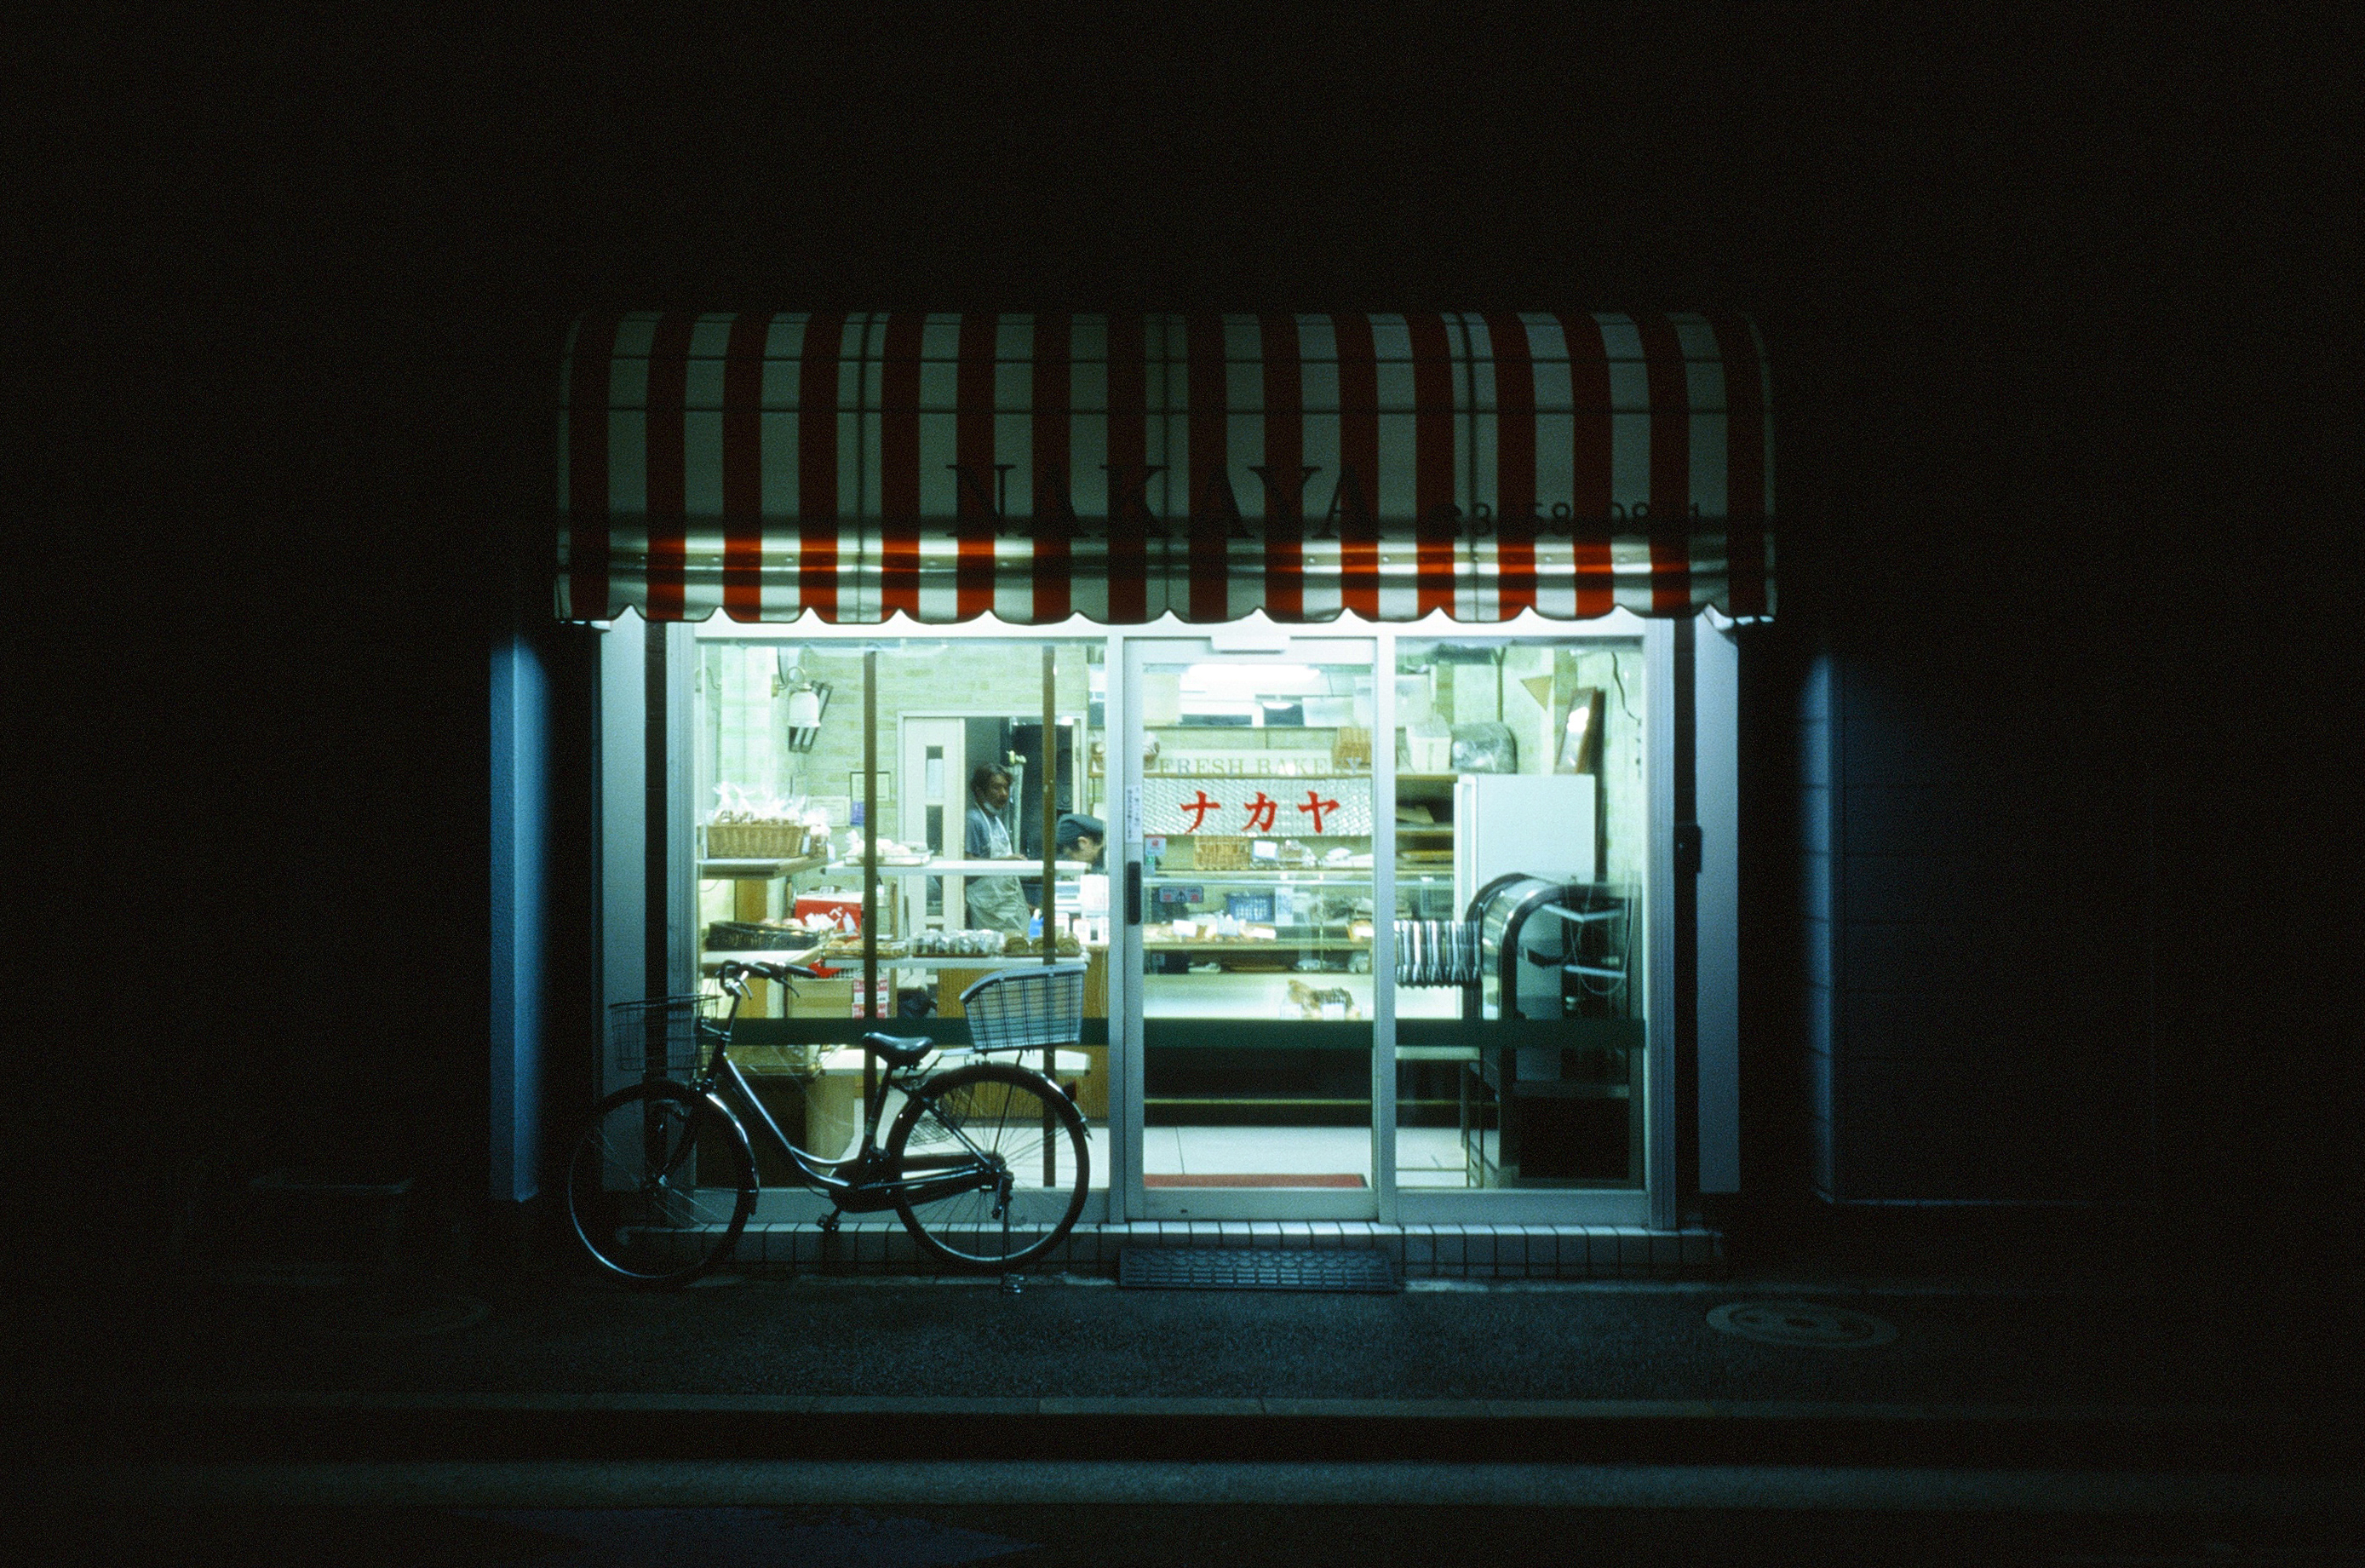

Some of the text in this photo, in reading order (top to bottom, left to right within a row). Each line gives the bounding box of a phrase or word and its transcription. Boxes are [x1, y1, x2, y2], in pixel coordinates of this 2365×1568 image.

[945, 465, 1384, 540] NAKAYA
[1158, 756, 1363, 776] FRESH BAKERY
[1179, 790, 1341, 835] ナカヤ
